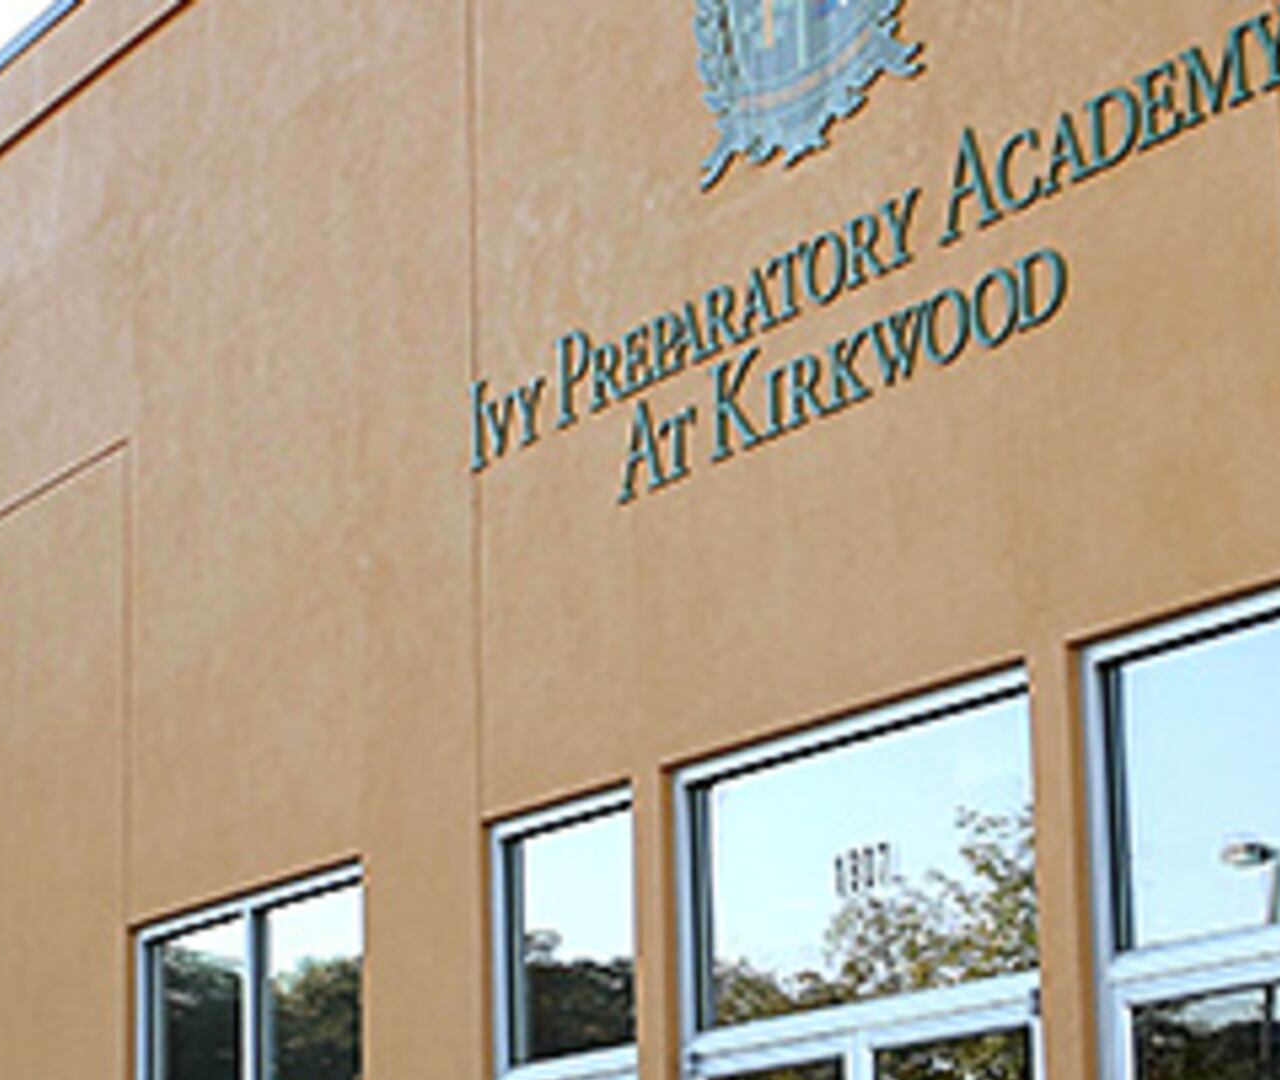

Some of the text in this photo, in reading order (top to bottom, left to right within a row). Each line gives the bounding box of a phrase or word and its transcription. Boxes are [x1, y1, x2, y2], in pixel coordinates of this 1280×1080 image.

[469, 378, 547, 473] IVY
[555, 187, 922, 431] PREPARATORY
[616, 247, 1069, 505] AT KIRKWOOD
